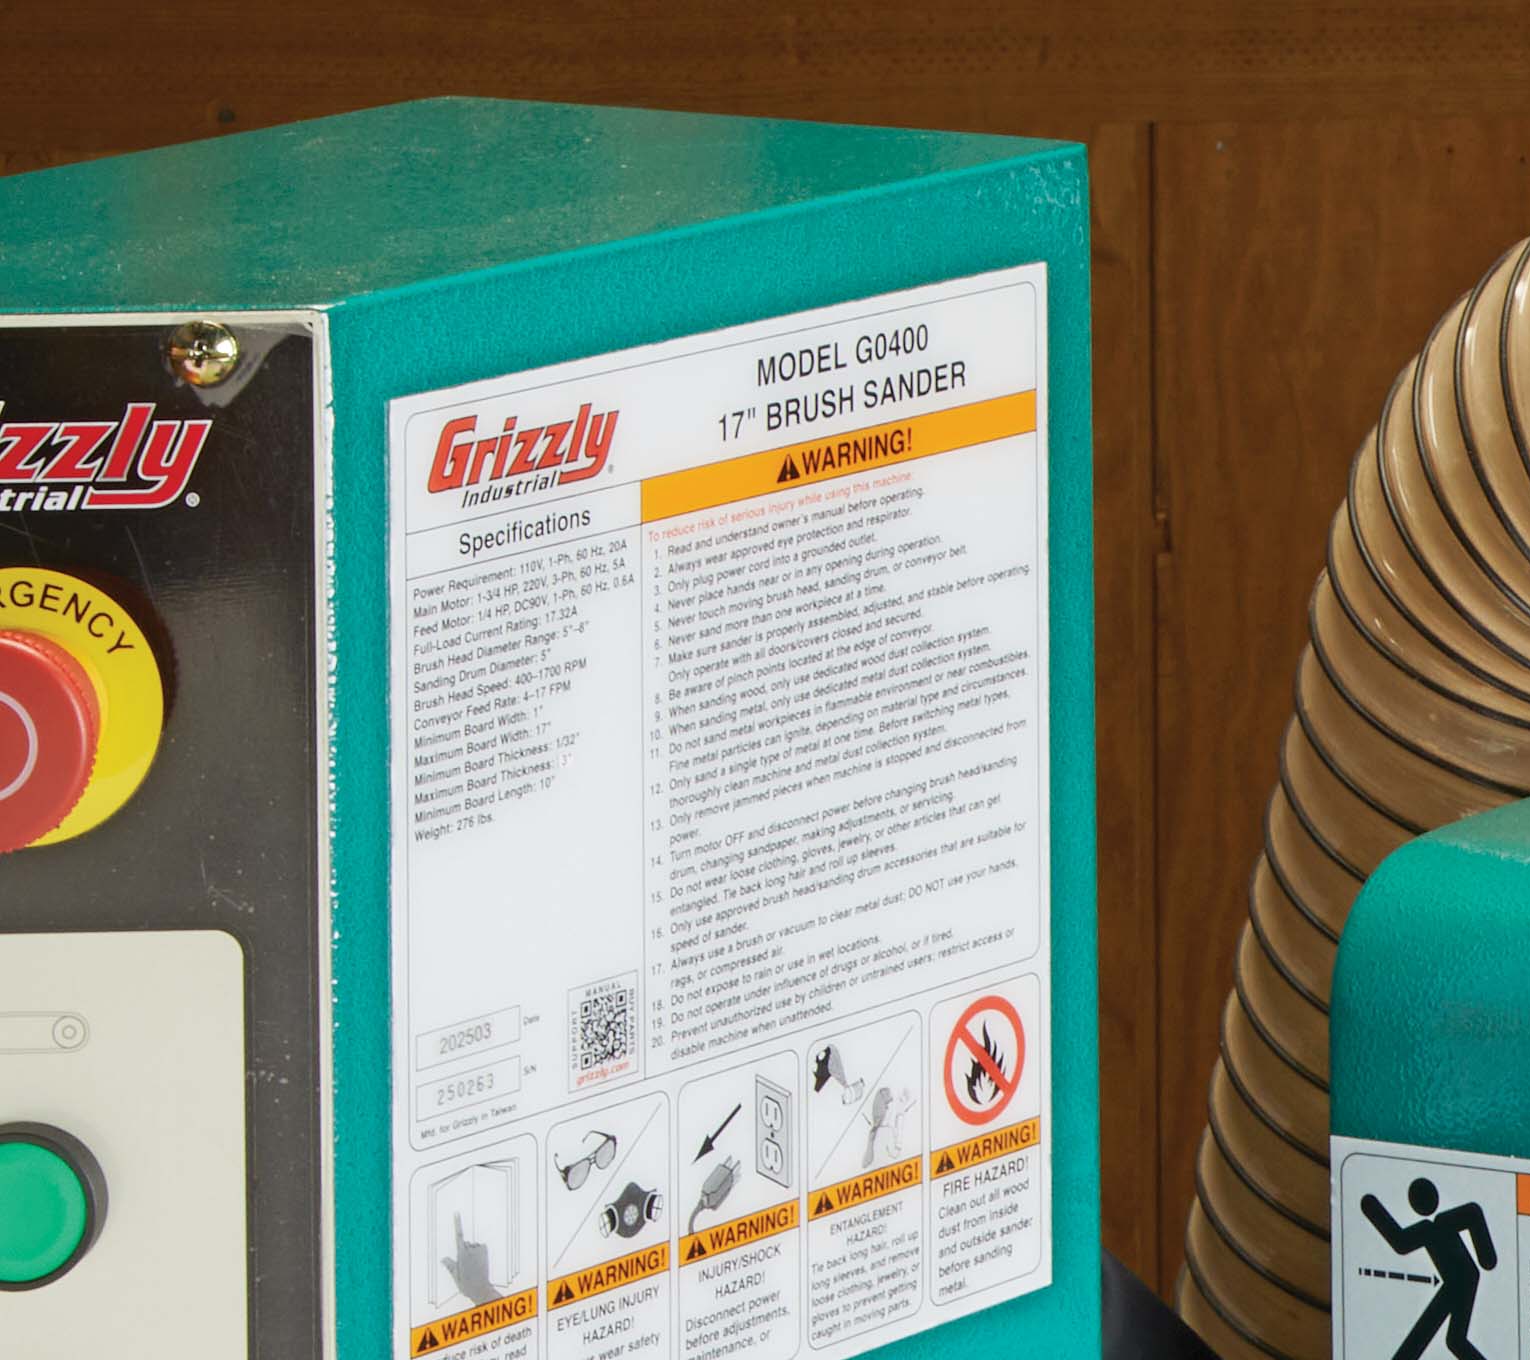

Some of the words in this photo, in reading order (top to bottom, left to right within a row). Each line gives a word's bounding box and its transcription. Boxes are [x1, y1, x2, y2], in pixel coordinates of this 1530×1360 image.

[757, 342, 848, 387] MODEL
[855, 323, 929, 365] G0400
[719, 407, 756, 441] 17"
[767, 385, 854, 432] BRUSH
[863, 360, 966, 409] SANDER
[0, 402, 213, 509] zzly
[427, 403, 619, 494] Grizzly
[798, 427, 912, 479] WARNING!
[461, 470, 562, 509] Industrial
[459, 509, 591, 559] Specifications
[956, 1123, 1036, 1165] WARNING!
[836, 1162, 918, 1206] WARNING!
[943, 1175, 970, 1197] FIRE
[974, 1156, 1029, 1187] HAZARD!
[709, 1205, 794, 1251] WARNING!
[830, 1200, 903, 1236] ENTANGLEMENT
[846, 1223, 886, 1246] HAZARD!
[577, 1248, 665, 1295] WARNING!
[698, 1243, 781, 1283] INJURY/SHOCK
[715, 1271, 765, 1299] HAZARD!
[441, 1295, 532, 1342] WARNING!
[557, 1300, 616, 1332] EYE/LUNG
[618, 1285, 659, 1310] INJURY
[583, 1316, 634, 1345] HAZARD!
[685, 1301, 746, 1333] Disconnect
[748, 1290, 780, 1314] power
[685, 1330, 720, 1351] before
[722, 1306, 790, 1338] adjustments,
[627, 1333, 659, 1353] safety
[759, 1329, 771, 1342] or
